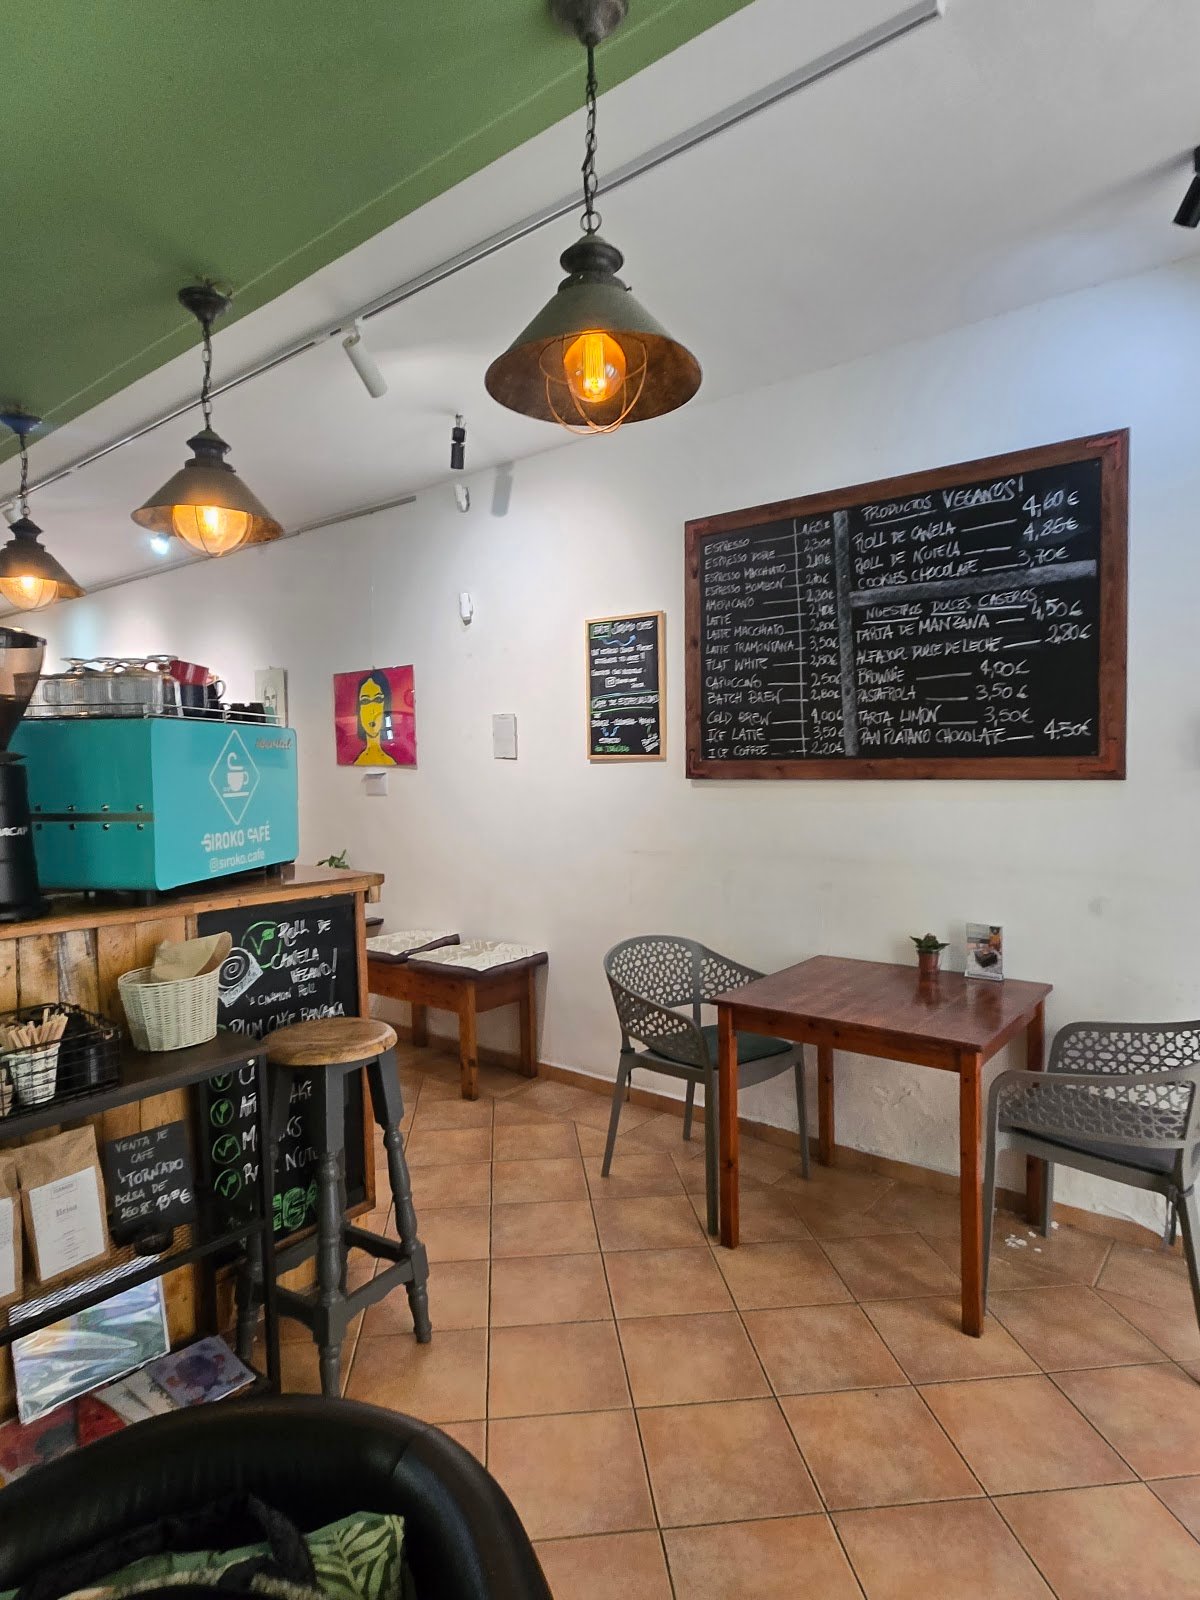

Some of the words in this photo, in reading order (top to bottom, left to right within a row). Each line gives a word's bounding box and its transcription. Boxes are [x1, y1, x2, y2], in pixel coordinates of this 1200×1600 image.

[861, 495, 931, 520] PRODUCTOS
[852, 531, 887, 554] ROLL
[891, 531, 906, 544] DE
[910, 521, 956, 542] CANELA
[704, 538, 750, 555] ESPRESSO
[704, 554, 748, 570] ESPRESSO
[854, 556, 884, 575] ROLL
[890, 550, 906, 566] DE
[704, 571, 740, 583] ESPRESSO
[858, 570, 908, 590] COOKIES
[911, 559, 978, 582] CHOCOLATE
[705, 583, 740, 596] ESPRESSO
[706, 613, 732, 626] LATTE
[706, 628, 732, 640] LATTE
[856, 624, 894, 643] TARTA
[898, 624, 914, 636] DE
[918, 614, 990, 634] MANZANA
[706, 644, 729, 655] LATTE
[962, 636, 1004, 654] LECHE
[705, 659, 730, 672] FLAT
[734, 656, 768, 671] WHITE
[707, 691, 743, 706] BATCH
[748, 688, 782, 704] BREW
[706, 712, 732, 724] COLD
[738, 712, 772, 725] BREW
[858, 709, 894, 726] TARTA
[706, 728, 727, 742] ICE
[732, 728, 766, 741] LATTE
[856, 728, 881, 746] PAN
[936, 726, 1007, 746] CHOCOLATE
[201, 828, 245, 853] SIROKO
[248, 821, 270, 842] CAFÉ
[270, 948, 320, 970] CANELA
[114, 1136, 150, 1153] VENTA
[126, 1158, 184, 1187] TORNADO
[152, 1180, 168, 1194] DE
